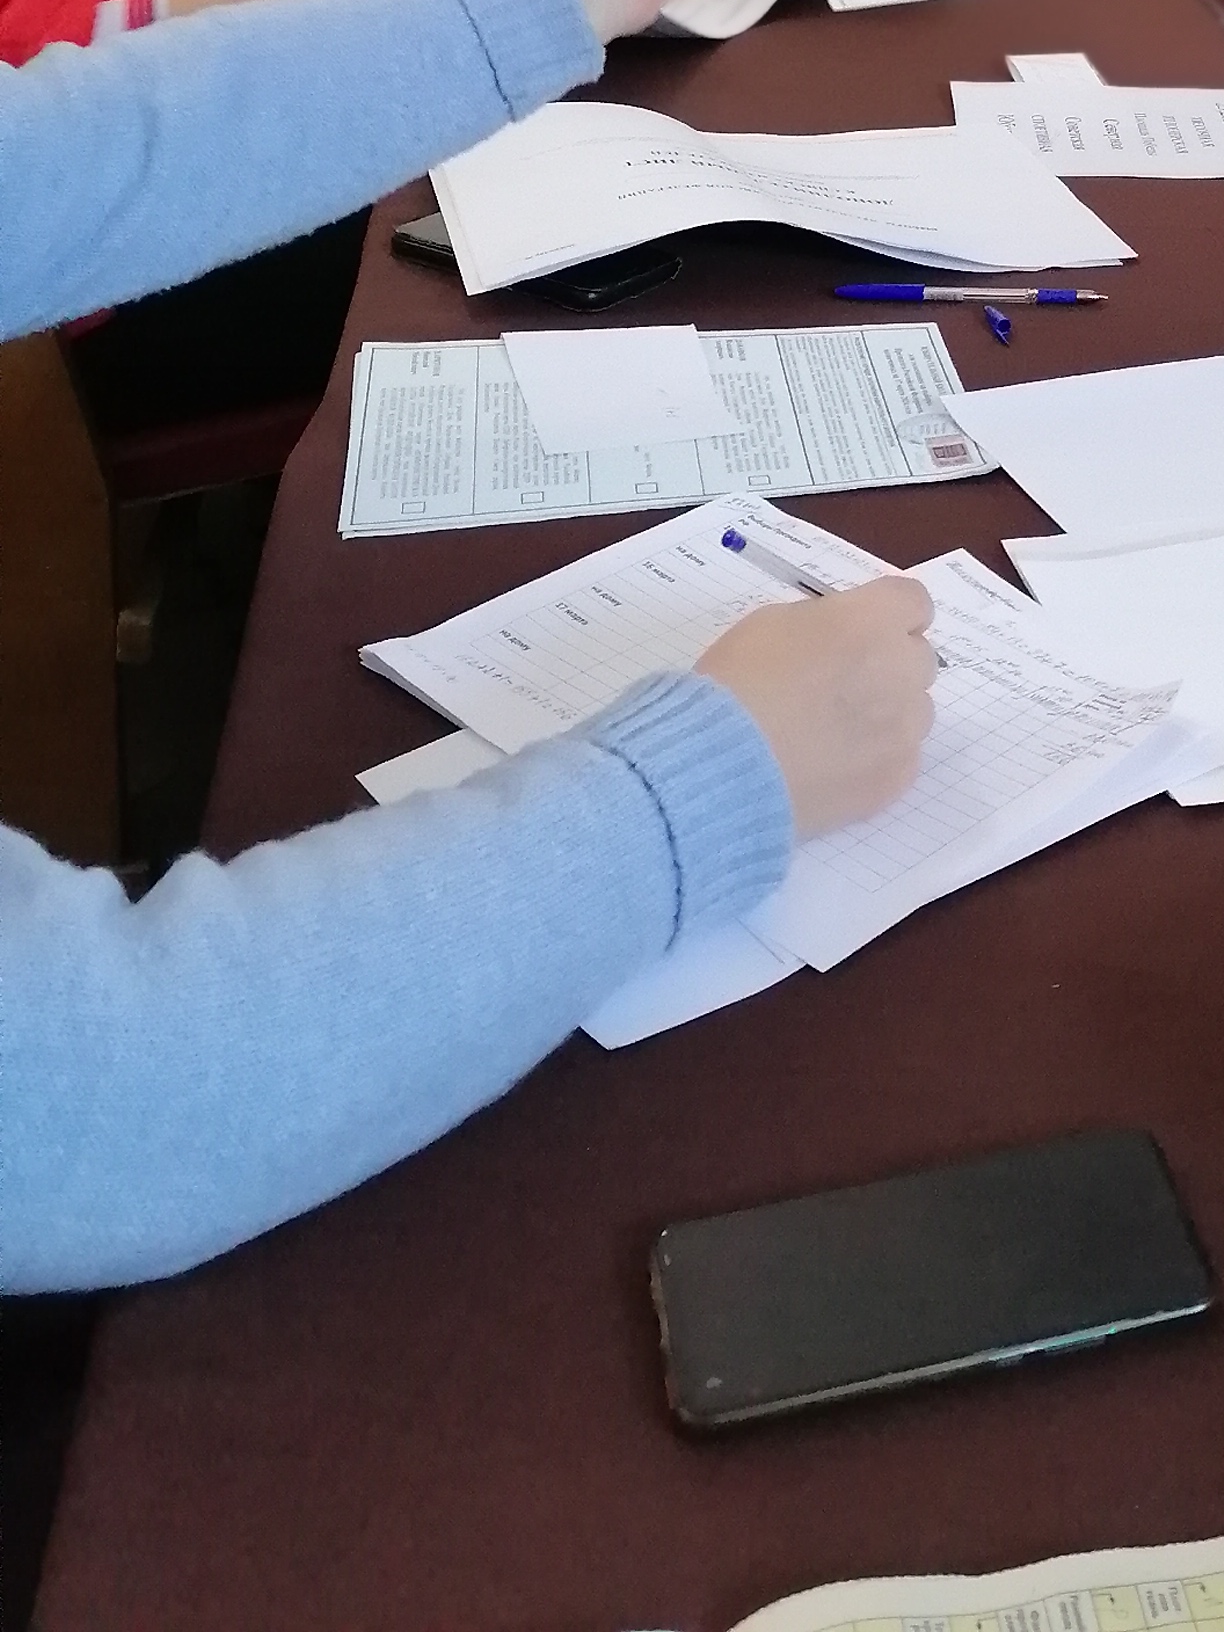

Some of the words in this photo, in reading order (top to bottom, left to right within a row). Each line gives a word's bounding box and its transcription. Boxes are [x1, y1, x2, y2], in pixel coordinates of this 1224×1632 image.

[672, 545, 689, 554] на
[680, 552, 710, 567] дому
[647, 568, 678, 584] марта
[587, 585, 603, 594] на
[595, 591, 625, 608] дому
[551, 601, 569, 611] 17
[559, 608, 592, 627] марта
[497, 629, 513, 638] на
[506, 635, 533, 652] дому
